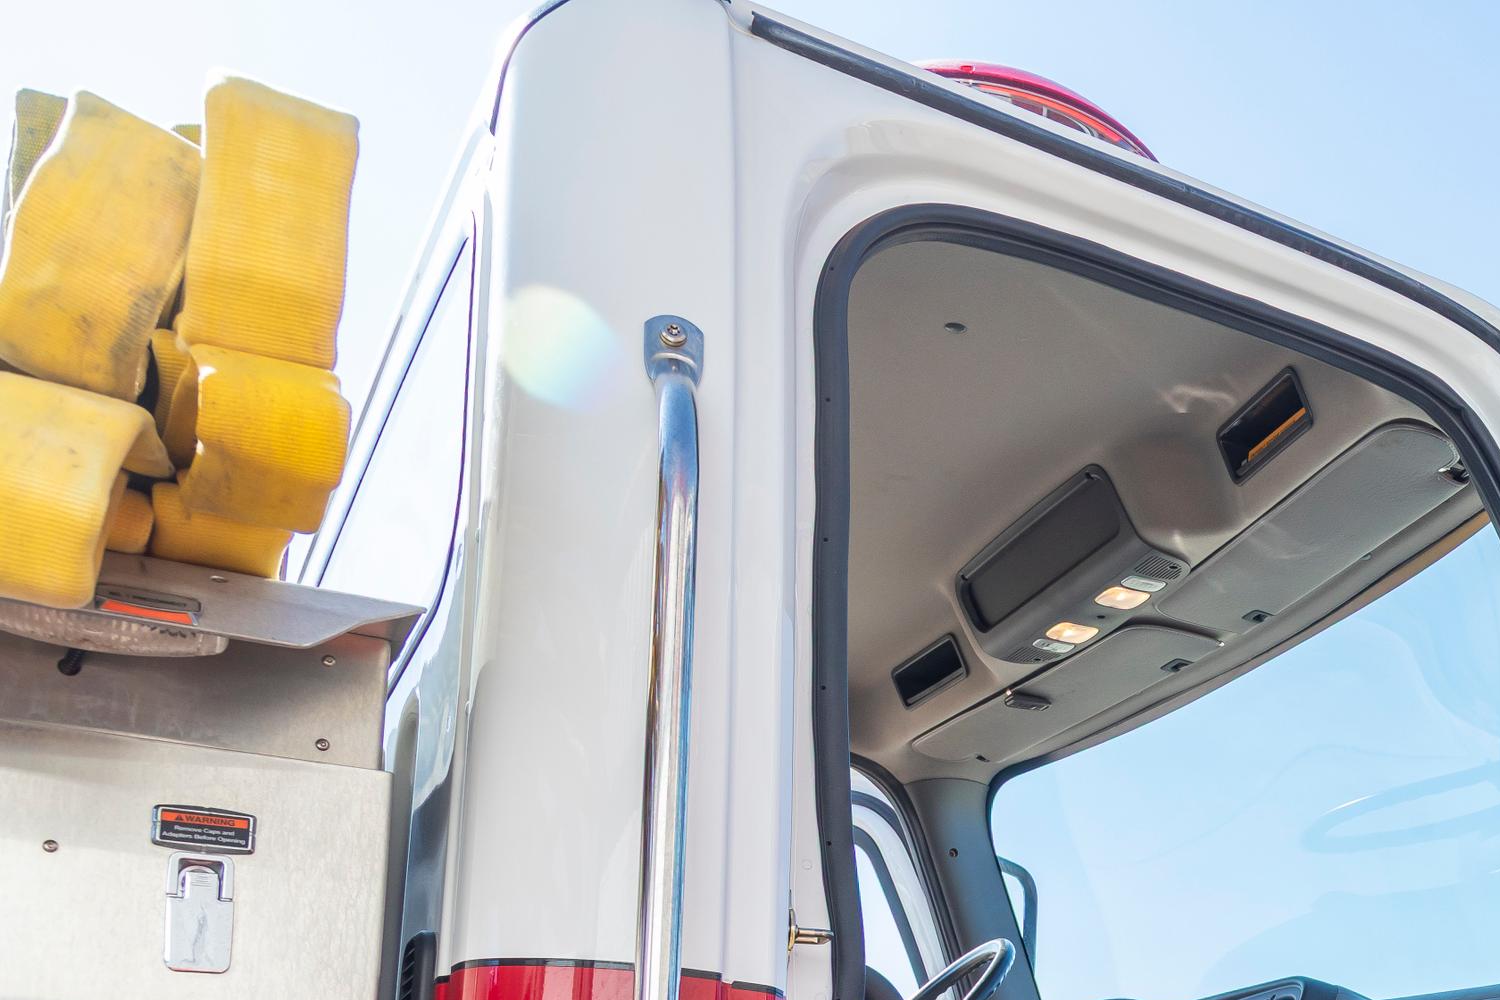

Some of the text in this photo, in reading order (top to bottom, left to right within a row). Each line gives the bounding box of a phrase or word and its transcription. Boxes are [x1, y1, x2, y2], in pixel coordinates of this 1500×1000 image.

[185, 815, 235, 826] WARNING
[174, 825, 202, 833] Remove
[217, 836, 246, 845] Opening
